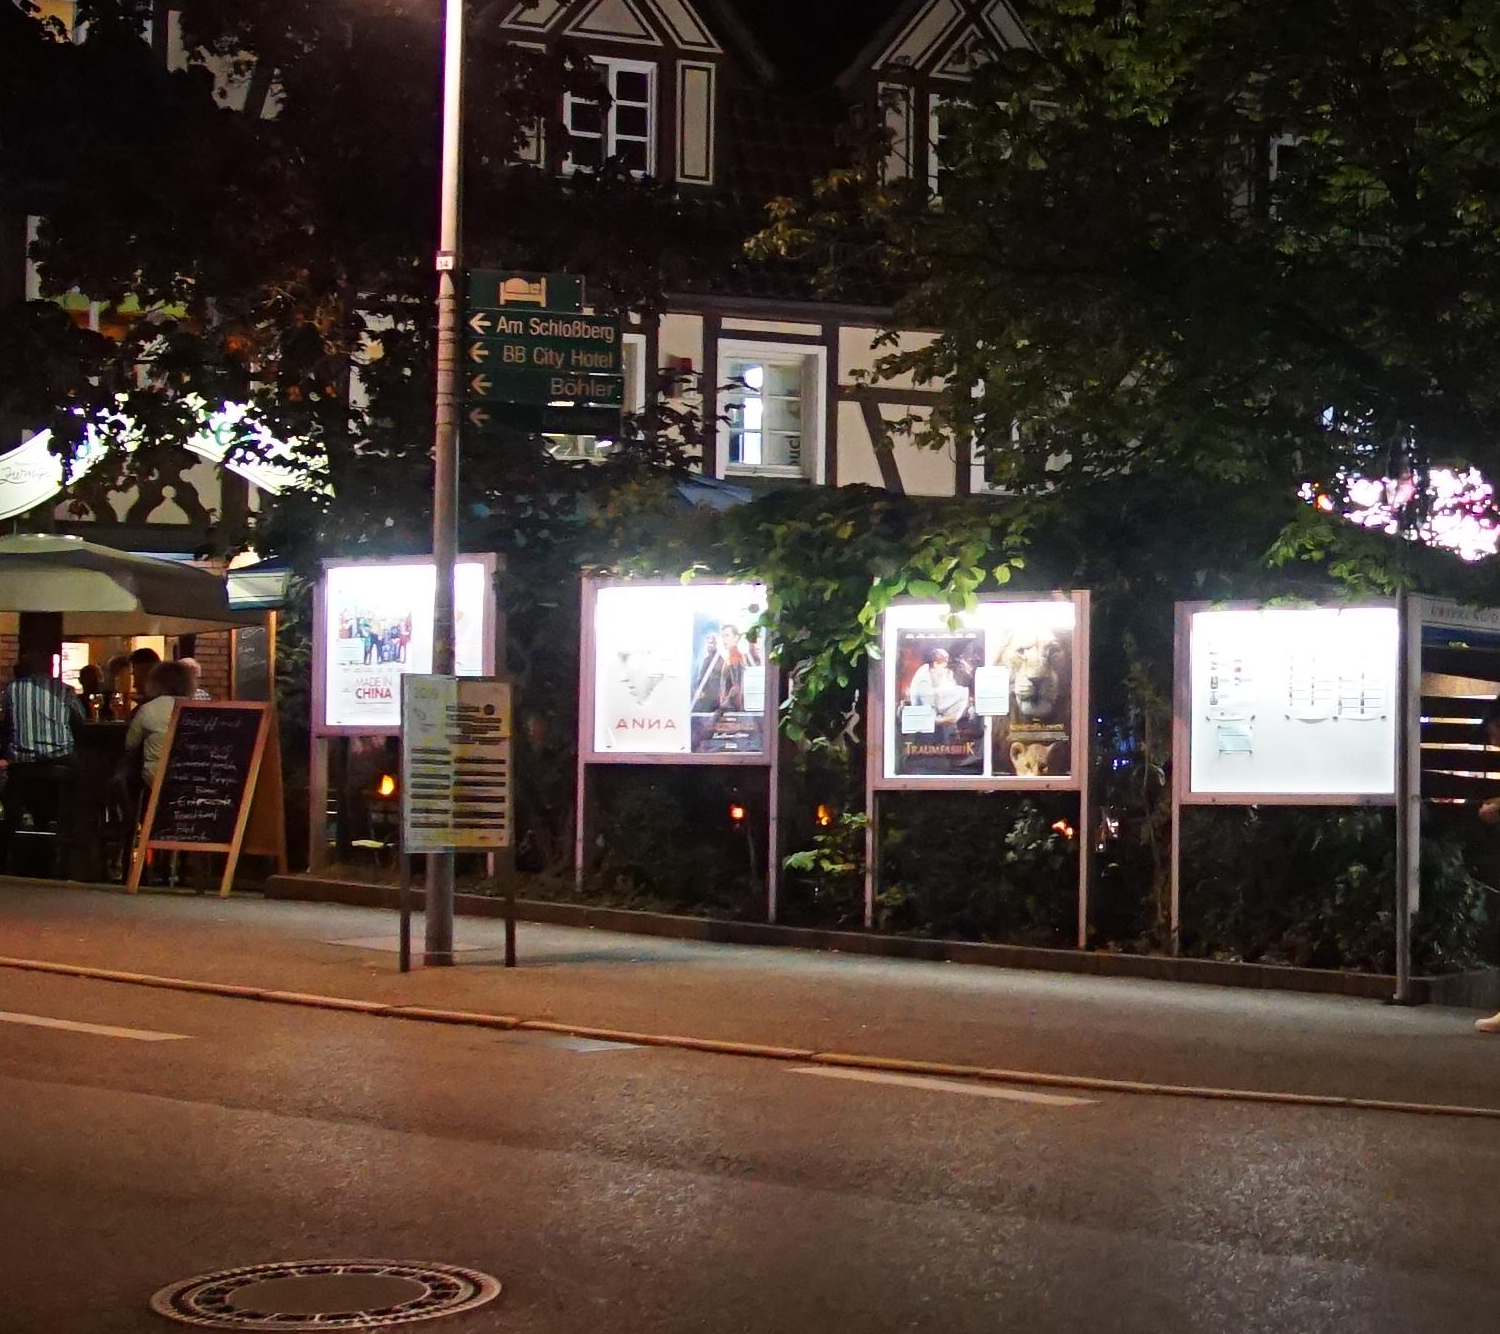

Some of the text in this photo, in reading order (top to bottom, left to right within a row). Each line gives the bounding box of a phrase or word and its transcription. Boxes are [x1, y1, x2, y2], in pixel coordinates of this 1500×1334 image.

[496, 316, 616, 344] Am Schloßberg
[502, 344, 614, 369] BB City Hotel
[550, 377, 615, 397] Böhler
[355, 687, 393, 700] CHINA
[903, 741, 976, 756] TRAUMFABRIK
